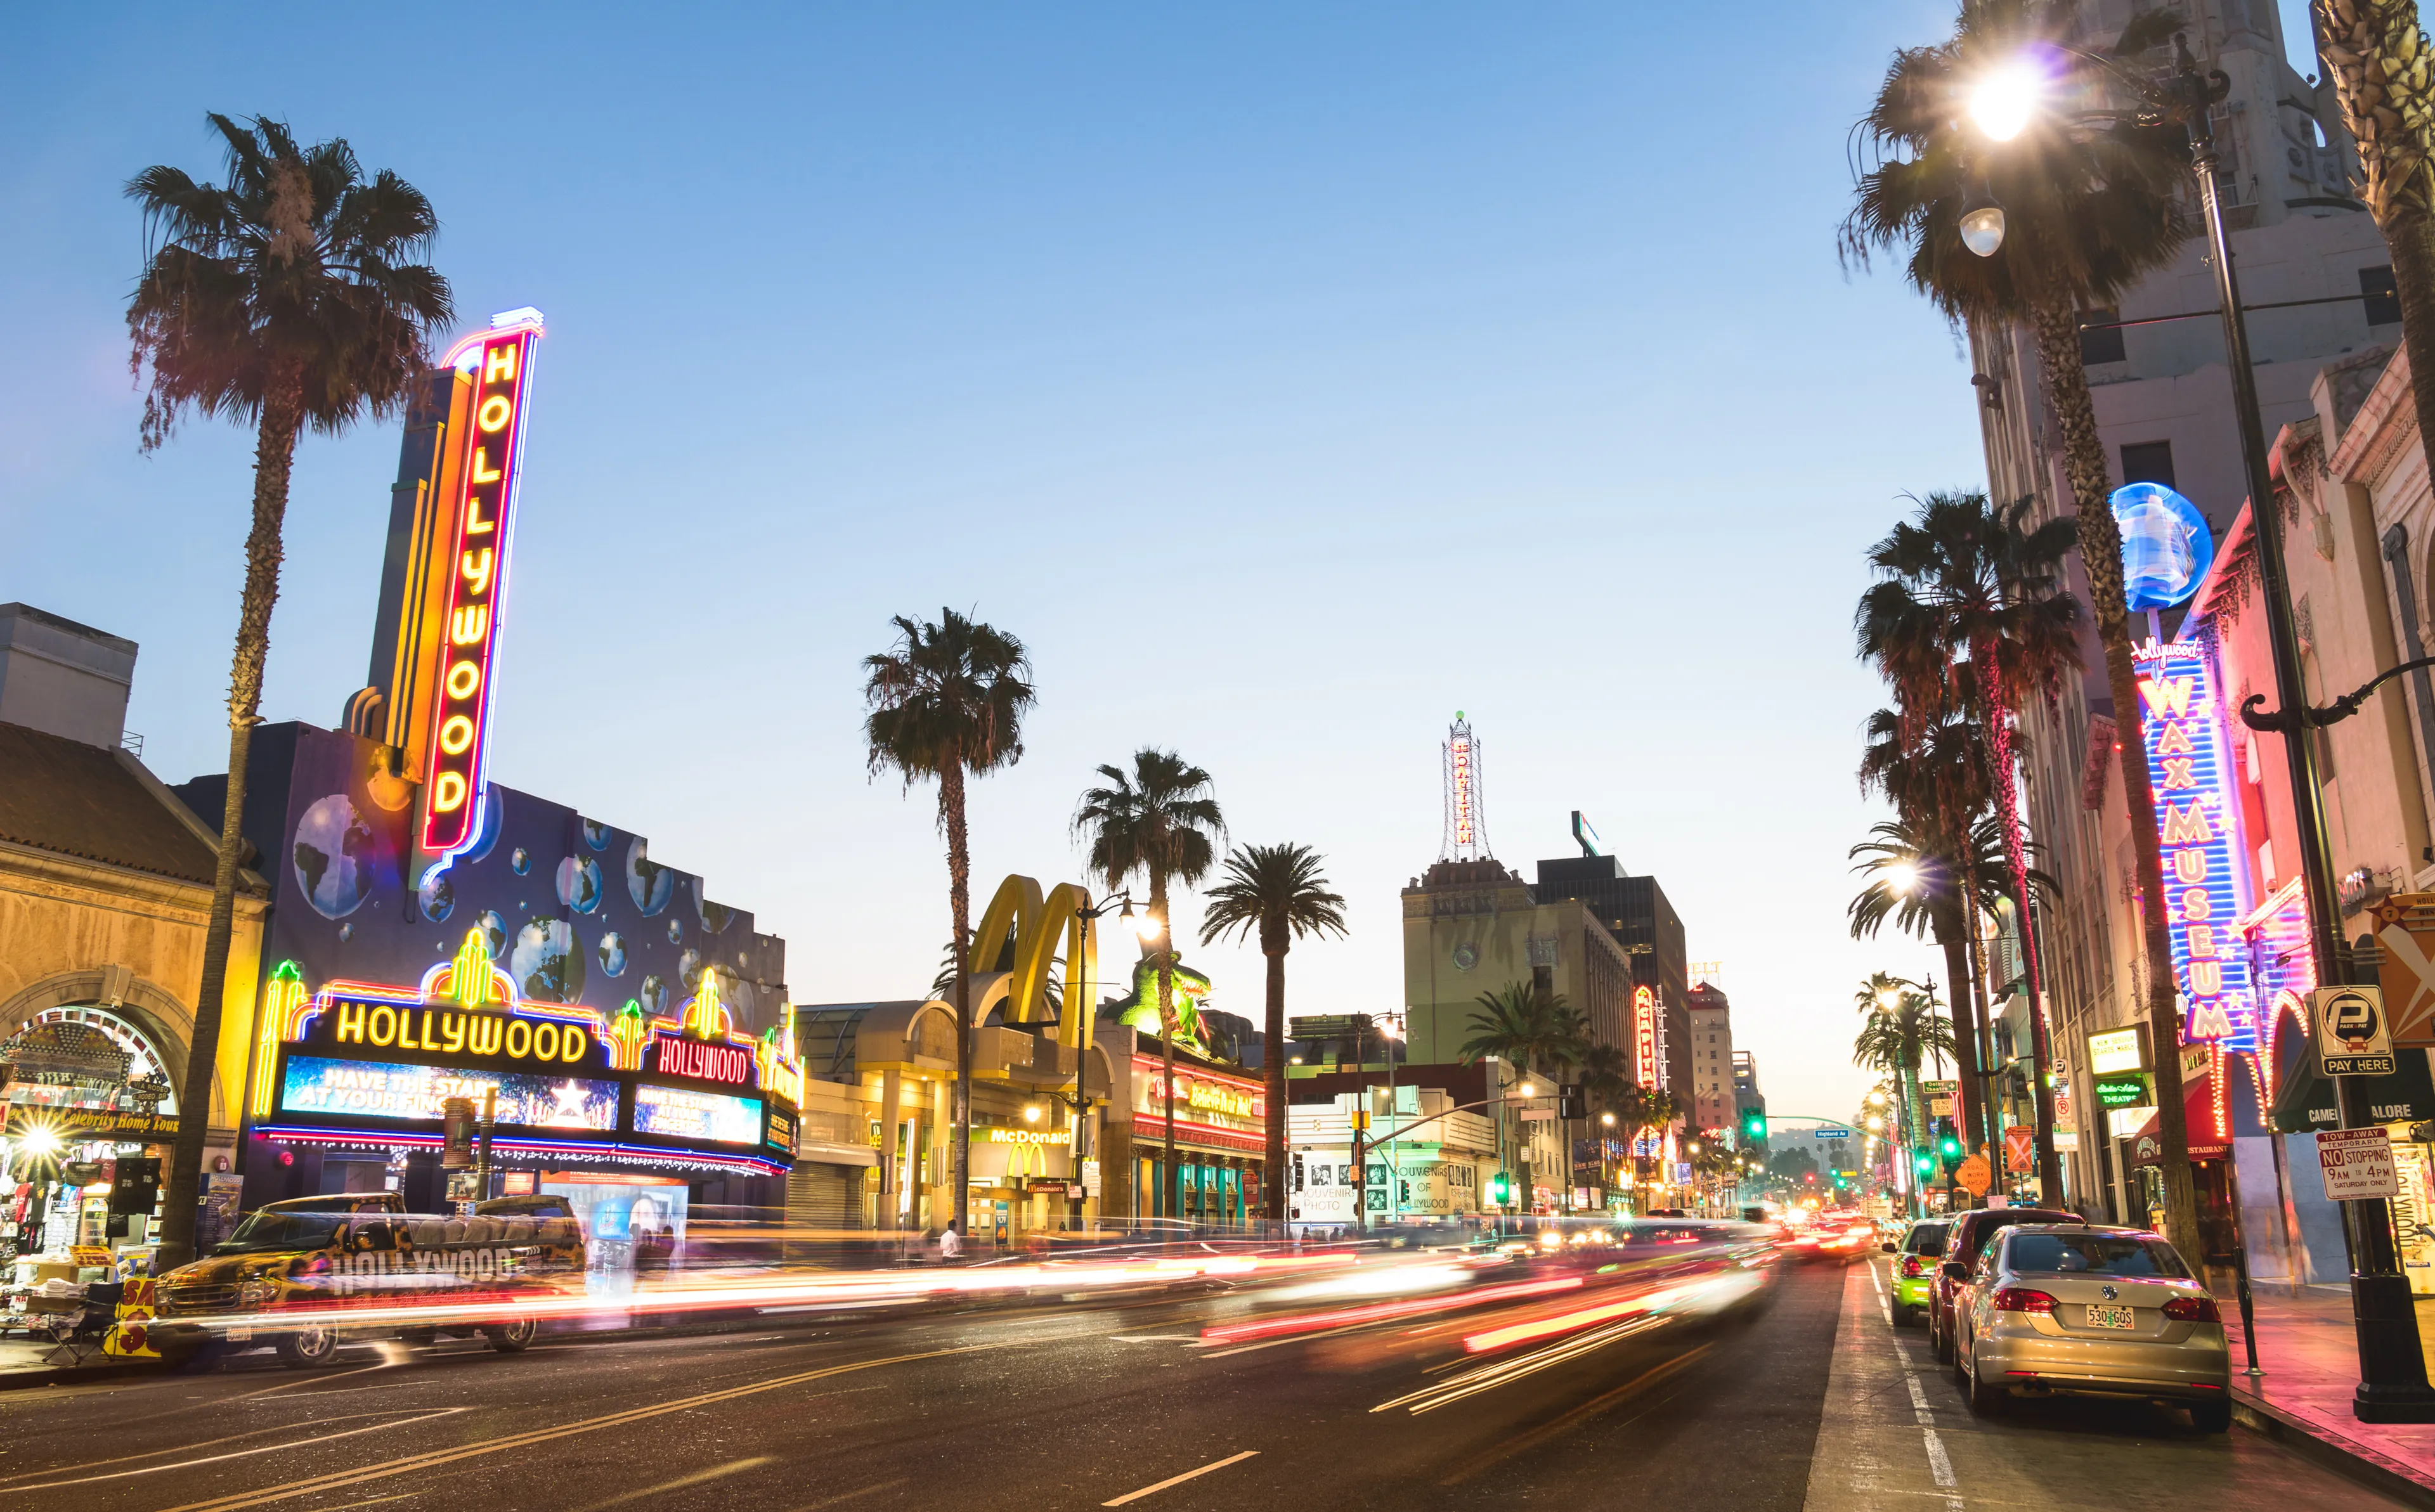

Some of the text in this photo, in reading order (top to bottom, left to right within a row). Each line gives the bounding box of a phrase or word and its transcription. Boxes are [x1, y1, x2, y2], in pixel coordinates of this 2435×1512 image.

[434, 343, 517, 813] HOLLYWOOD
[2130, 636, 2199, 669] Hollywood
[2137, 676, 2197, 790] WAX
[2161, 796, 2235, 1038] MUSEUM
[337, 1002, 586, 1063] HOLLYWOOD
[2093, 1046, 2114, 1056] STARTS
[659, 1038, 747, 1084] HOLLYWOOD
[2328, 1059, 2390, 1072] PAY HERE
[134, 1082, 169, 1094] VIA RODEO
[325, 1069, 385, 1092] HAVE
[390, 1073, 432, 1094] THE
[299, 1087, 330, 1106] AT
[335, 1089, 397, 1111] YOUR
[399, 1092, 518, 1118] FINGTPS
[2372, 1104, 2412, 1118] ALORE
[61, 1109, 116, 1130] Celebrity
[117, 1113, 150, 1130] Home
[2323, 1130, 2379, 1141] TOW-AWAY
[2327, 1139, 2379, 1149] TEMPORARY
[2323, 1149, 2389, 1166] NO STOPPING
[211, 1175, 241, 1184] HOLLYWOOD
[2328, 1168, 2350, 1180] 9AM
[2367, 1165, 2390, 1178] 4PM
[1029, 1184, 1063, 1192] McDonald's
[1417, 1183, 1431, 1192] OF
[2334, 1180, 2368, 1189] SATURDAY
[1304, 1188, 1354, 1198] SOUVENIRS
[1304, 1199, 1340, 1210] PHOTO
[332, 1248, 512, 1296] HOLLYWOOD
[2089, 1310, 2132, 1324] 530 GQS
